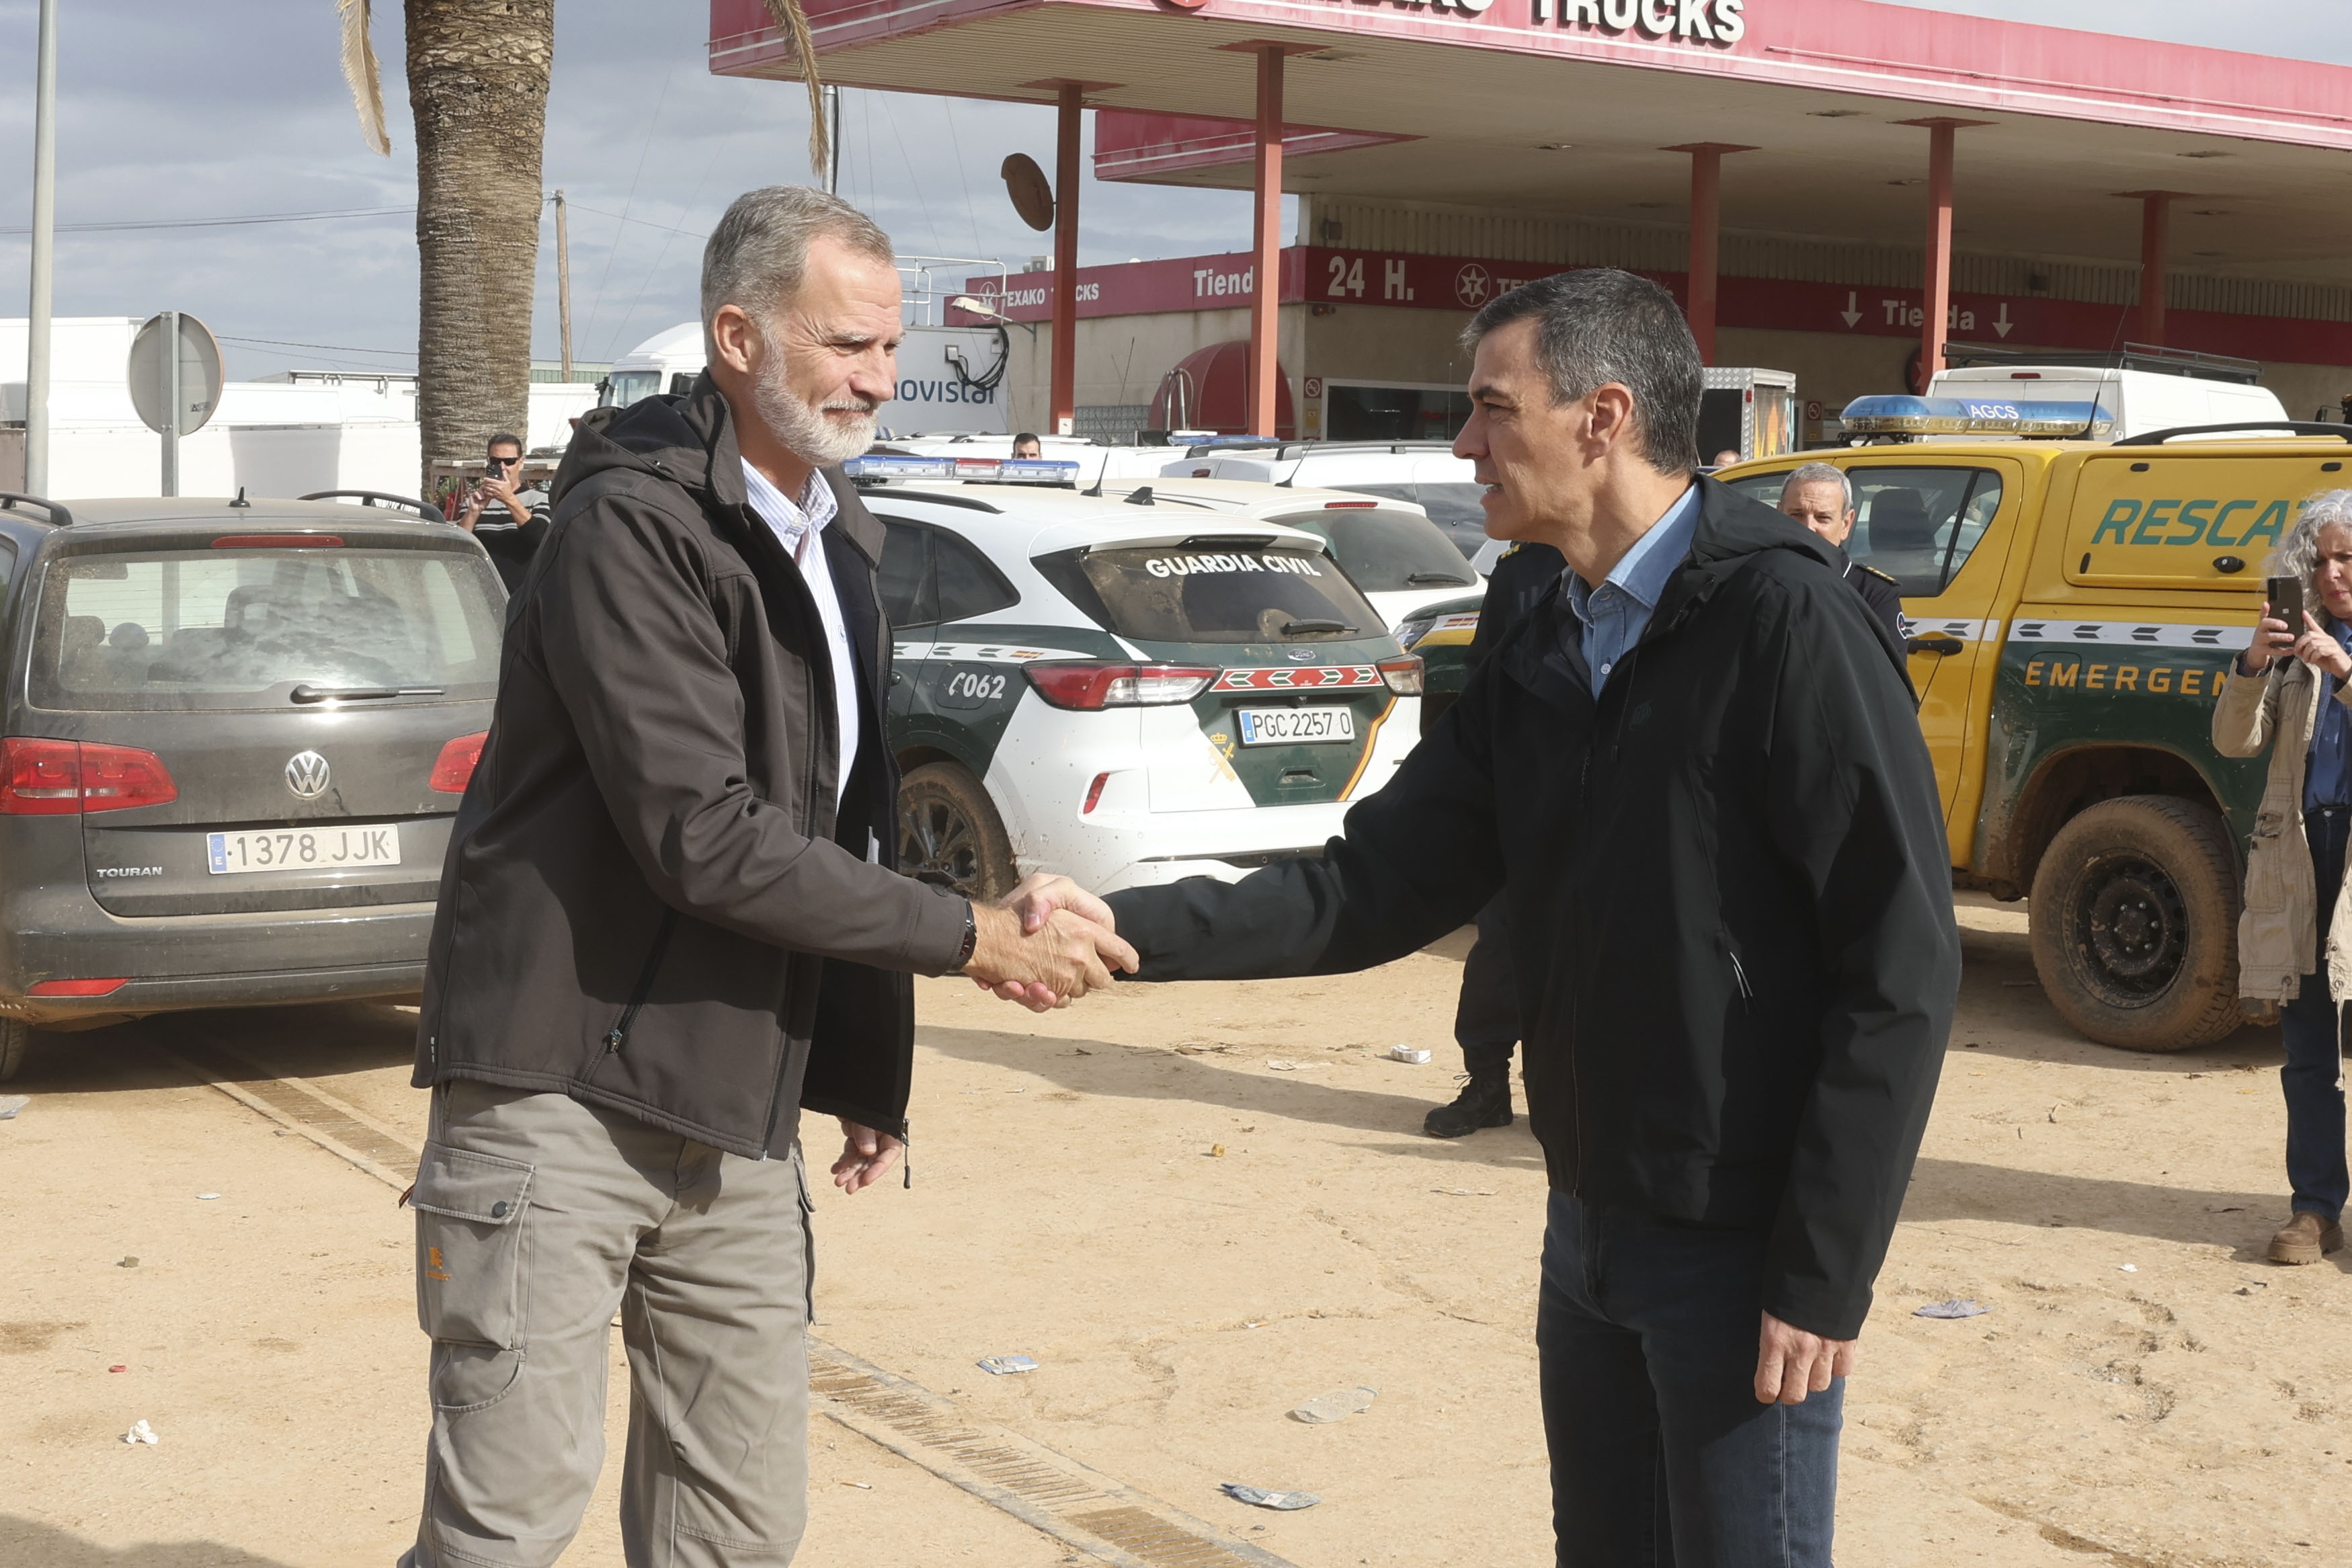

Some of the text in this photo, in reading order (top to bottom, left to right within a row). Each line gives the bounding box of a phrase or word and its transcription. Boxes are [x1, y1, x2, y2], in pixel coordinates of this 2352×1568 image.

[1193, 266, 1254, 297] Tiend
[1327, 255, 1414, 301] 24 H.
[1882, 300, 1975, 331] Tieda
[893, 378, 994, 405] ovistar
[1970, 404, 2019, 419] AGCS
[2091, 499, 2315, 547] RESCA
[1145, 554, 1322, 578] GUARDIA CIVIL
[963, 673, 1006, 699] 062
[1252, 712, 1288, 738] PGC
[1290, 712, 1332, 736] 2257
[237, 833, 317, 866] 1378
[331, 830, 390, 862] JJK
[96, 866, 163, 878] TOURAN
